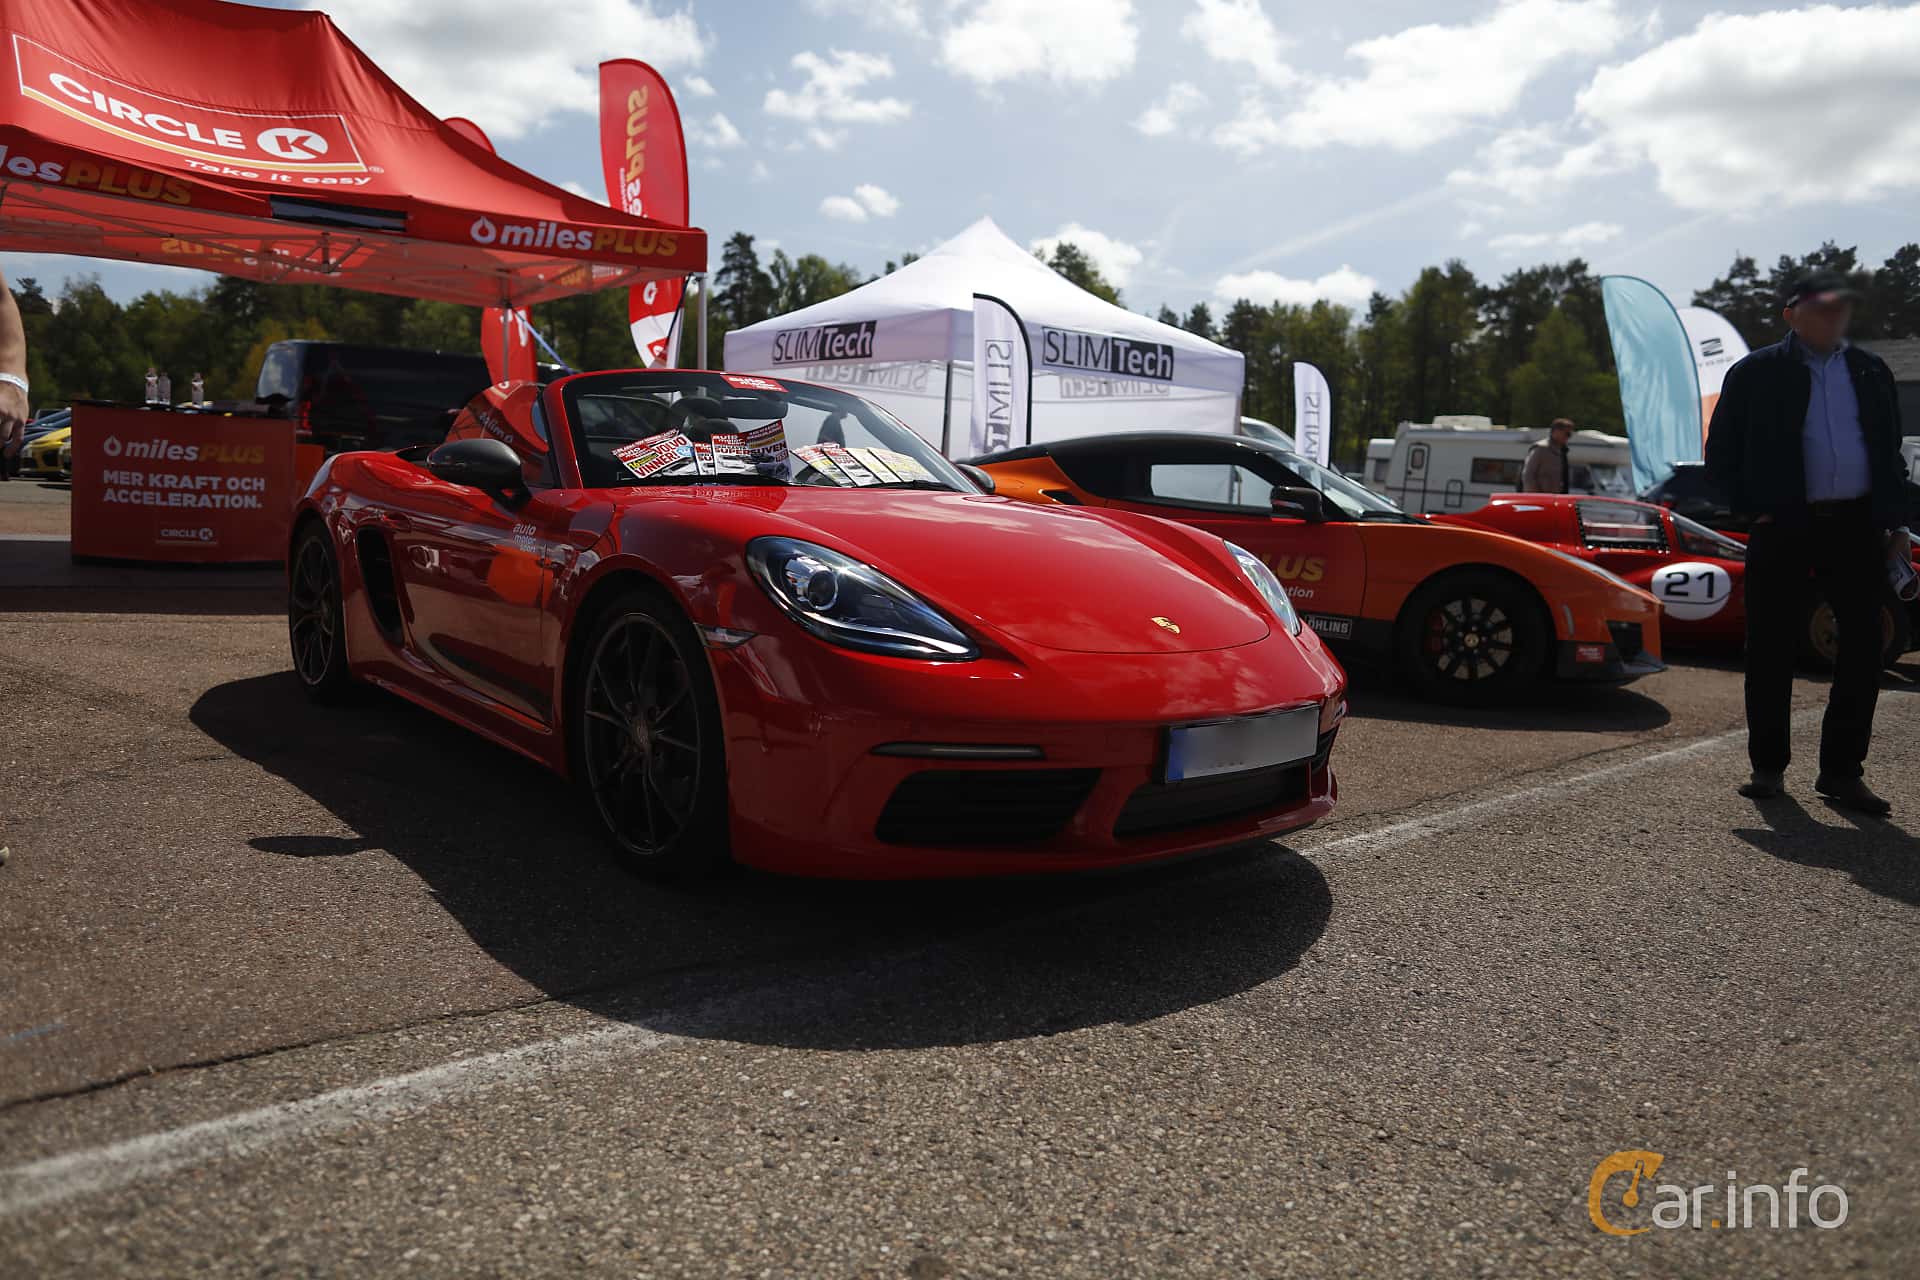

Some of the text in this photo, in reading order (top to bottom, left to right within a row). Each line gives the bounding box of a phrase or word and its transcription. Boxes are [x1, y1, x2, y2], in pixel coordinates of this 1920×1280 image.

[49, 73, 328, 160] CIRCLE K
[184, 159, 371, 185] Take it easy
[774, 322, 873, 362] SLIMTech
[1045, 330, 1173, 379] SLIMTech
[654, 437, 687, 454] VOLVO
[635, 450, 680, 476] VINNER!
[103, 470, 265, 491] MER KRAFT OCH
[103, 488, 263, 509] ACCELERATION.
[1664, 571, 1716, 599] 21
